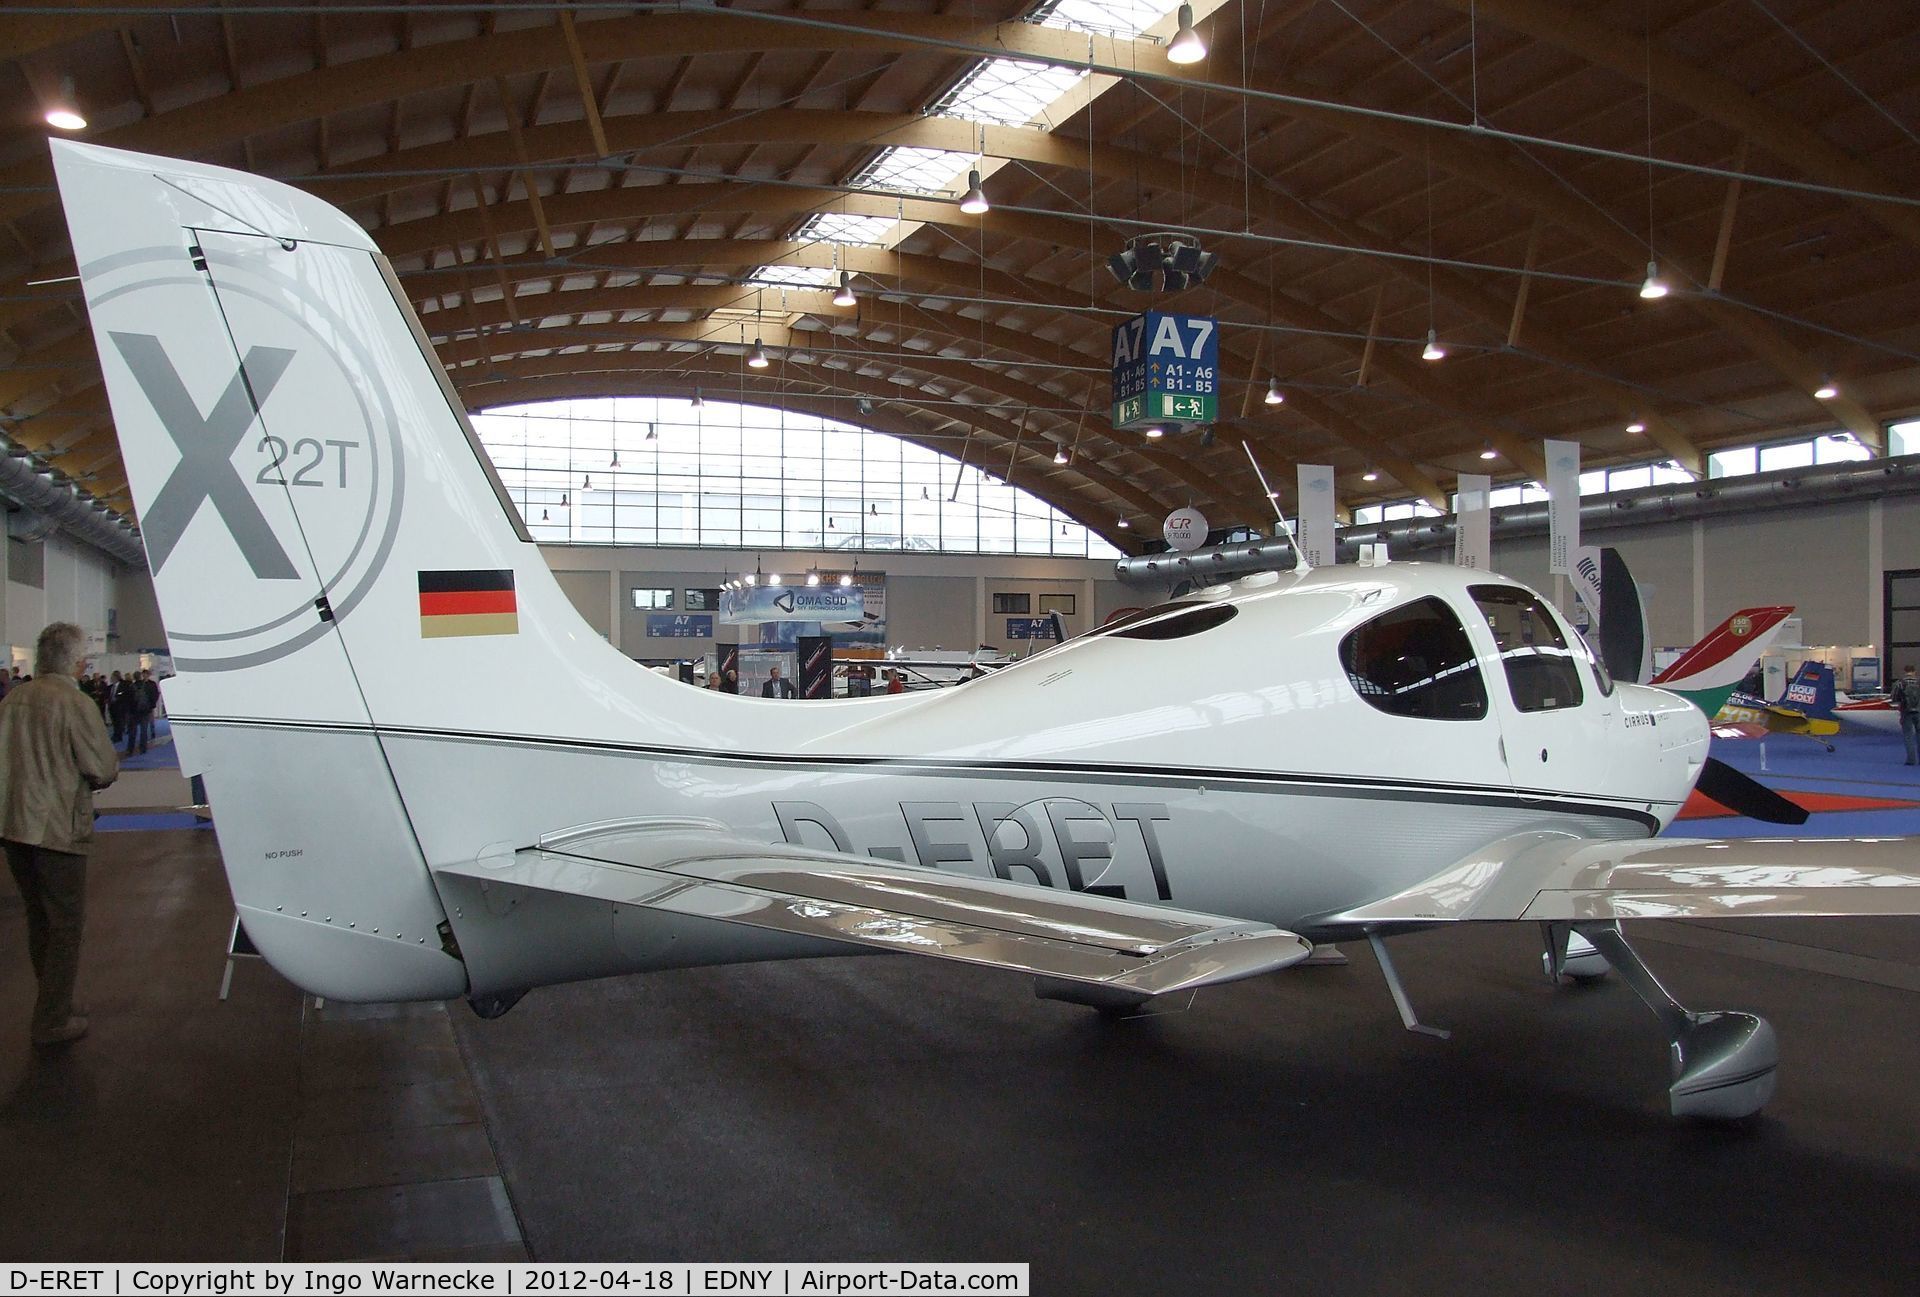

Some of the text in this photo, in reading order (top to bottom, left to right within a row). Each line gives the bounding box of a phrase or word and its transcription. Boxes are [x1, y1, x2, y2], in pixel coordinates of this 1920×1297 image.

[1114, 317, 1145, 369] A7
[1149, 316, 1213, 360] A7
[1166, 364, 1183, 377] A1
[1195, 366, 1213, 379] A6
[1166, 378, 1183, 391] B1
[1195, 381, 1213, 393] B5
[107, 331, 359, 579] X 22T
[797, 596, 848, 606] OMA SUD
[674, 615, 690, 625] A7
[1030, 619, 1043, 628] A7
[1789, 684, 1814, 695] LIQUI
[1788, 692, 1814, 704] MOLY
[1624, 714, 1649, 728] CIRRUS
[265, 849, 304, 860] NO PUSH
[771, 801, 1173, 900] D-ERET
